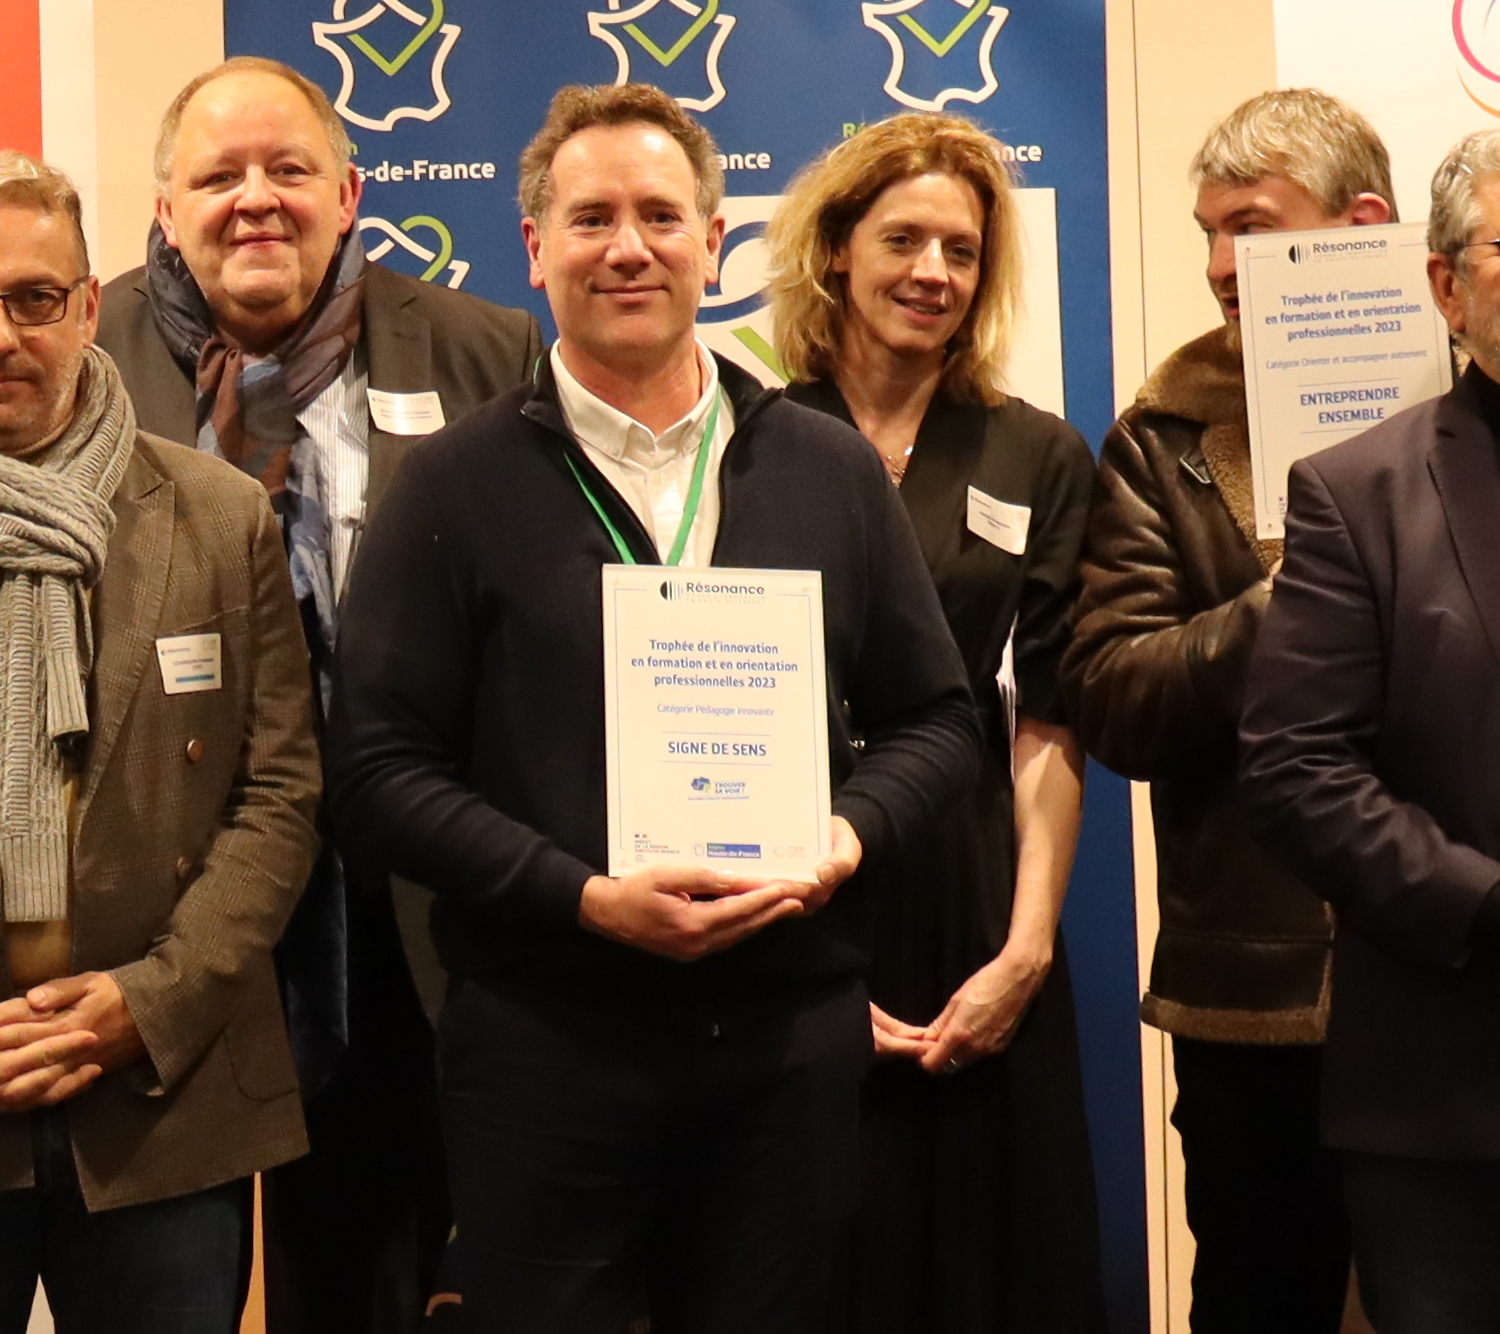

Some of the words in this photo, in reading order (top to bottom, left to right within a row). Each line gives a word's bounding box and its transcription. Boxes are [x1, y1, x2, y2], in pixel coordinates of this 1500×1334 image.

[1313, 240, 1387, 254] Résonance
[1280, 293, 1323, 307] Trophée
[1326, 291, 1338, 303] de
[1265, 316, 1278, 325] en
[1280, 310, 1332, 323] formation
[1334, 309, 1346, 319] et
[1347, 309, 1360, 318] en
[1362, 303, 1421, 317] orientation
[1287, 324, 1372, 342] professionnelles
[1374, 320, 1401, 333] 2023
[1300, 386, 1399, 406] ENTREPRENDRE
[1318, 407, 1384, 424] ENSEMBLE
[686, 582, 764, 594] Résonance
[649, 639, 694, 653] Trophée
[697, 641, 710, 652] de
[631, 658, 644, 666] en
[647, 656, 702, 668] formation
[705, 660, 716, 669] et
[720, 661, 732, 669] en
[736, 659, 797, 671] orientation
[654, 674, 744, 687] professionnelles
[748, 676, 775, 688] 2023
[668, 741, 707, 754] SIGNE
[711, 743, 728, 754] DE
[732, 743, 766, 756] SENS
